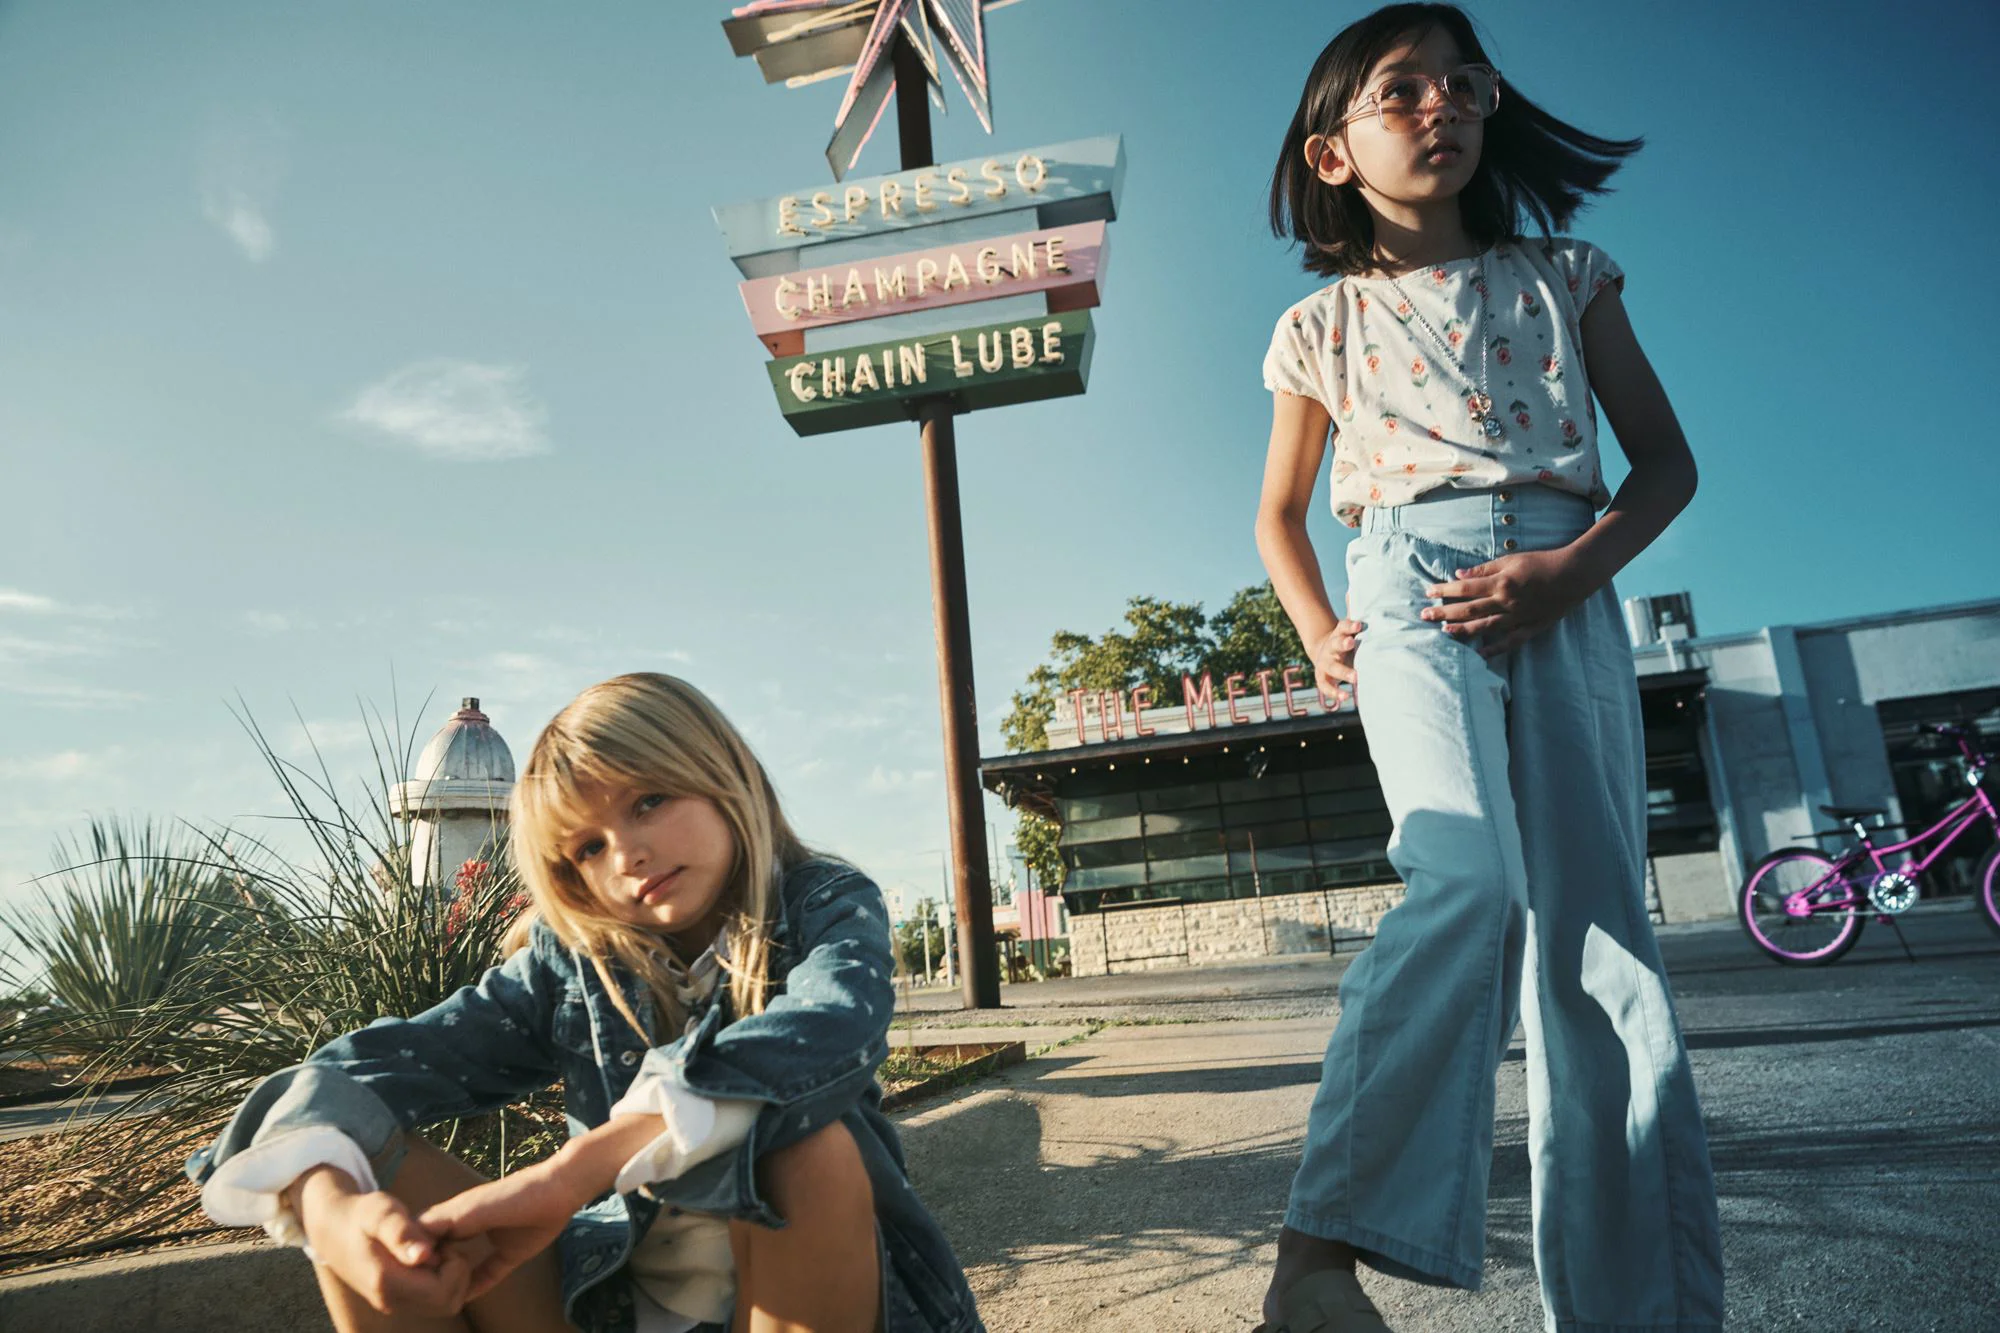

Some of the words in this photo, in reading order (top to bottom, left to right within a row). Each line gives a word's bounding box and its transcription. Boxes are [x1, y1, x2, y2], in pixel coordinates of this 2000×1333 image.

[777, 154, 1047, 236] ESPRESSO
[775, 236, 1070, 321] CHAMPAGNE
[785, 342, 926, 402] CHAIN
[951, 322, 1064, 378] LUBE
[1067, 684, 1156, 745] THE
[1181, 665, 1358, 732] METE
